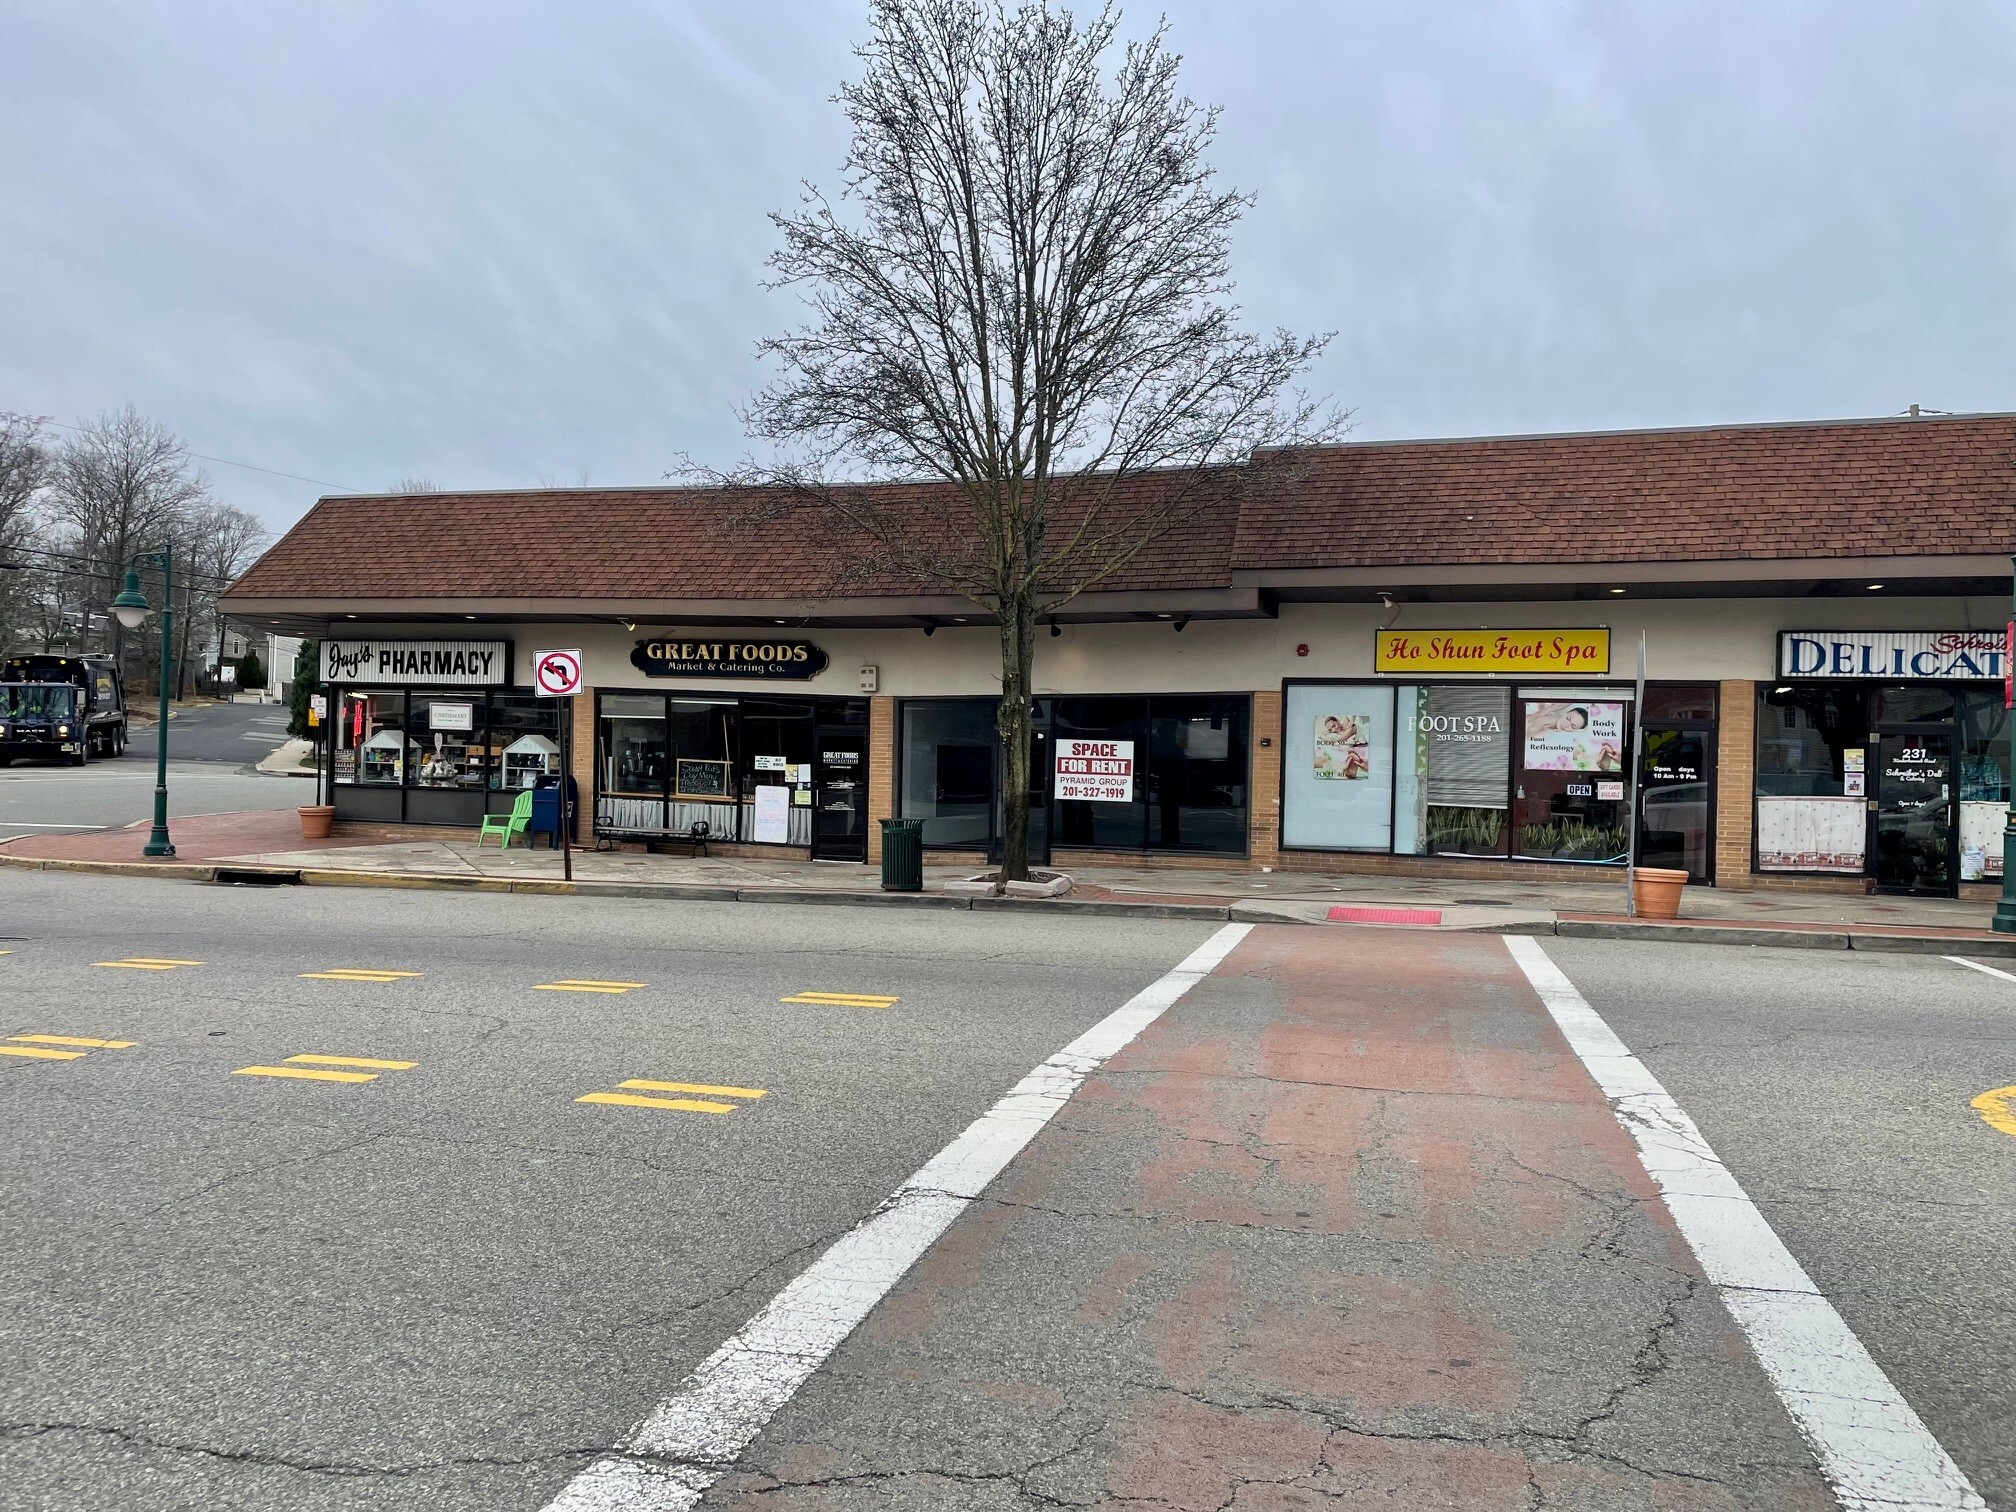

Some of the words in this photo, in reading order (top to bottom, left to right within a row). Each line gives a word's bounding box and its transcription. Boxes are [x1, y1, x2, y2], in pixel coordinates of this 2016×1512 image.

[647, 643, 723, 660] GREAT
[728, 644, 808, 662] FOODS
[1386, 637, 1422, 660] Ho
[1427, 637, 1485, 660] Shun
[1491, 636, 1544, 660] Foot
[1549, 636, 1598, 666] Spa
[328, 643, 374, 679] Jay's
[379, 650, 494, 675] PHARMACY
[668, 661, 703, 671] Market
[707, 662, 716, 671] &
[719, 662, 765, 675] Catering
[768, 663, 786, 673] Co.
[1407, 715, 1461, 733] FOOT
[1463, 716, 1501, 733] SPA
[1592, 719, 1616, 729] Body
[1436, 734, 1492, 743] 201-265-1188
[1592, 729, 1617, 737] Work
[1072, 742, 1118, 757] SPACE
[1530, 744, 1574, 752] Reflexology
[1902, 748, 1927, 759] 231
[1060, 758, 1088, 773] FOR
[1091, 759, 1128, 774] RENT
[1060, 776, 1096, 785] PYRAMID
[1098, 777, 1128, 786] GROUP
[1062, 785, 1125, 799] 201-327-1919
[1569, 784, 1590, 795] OPEN
